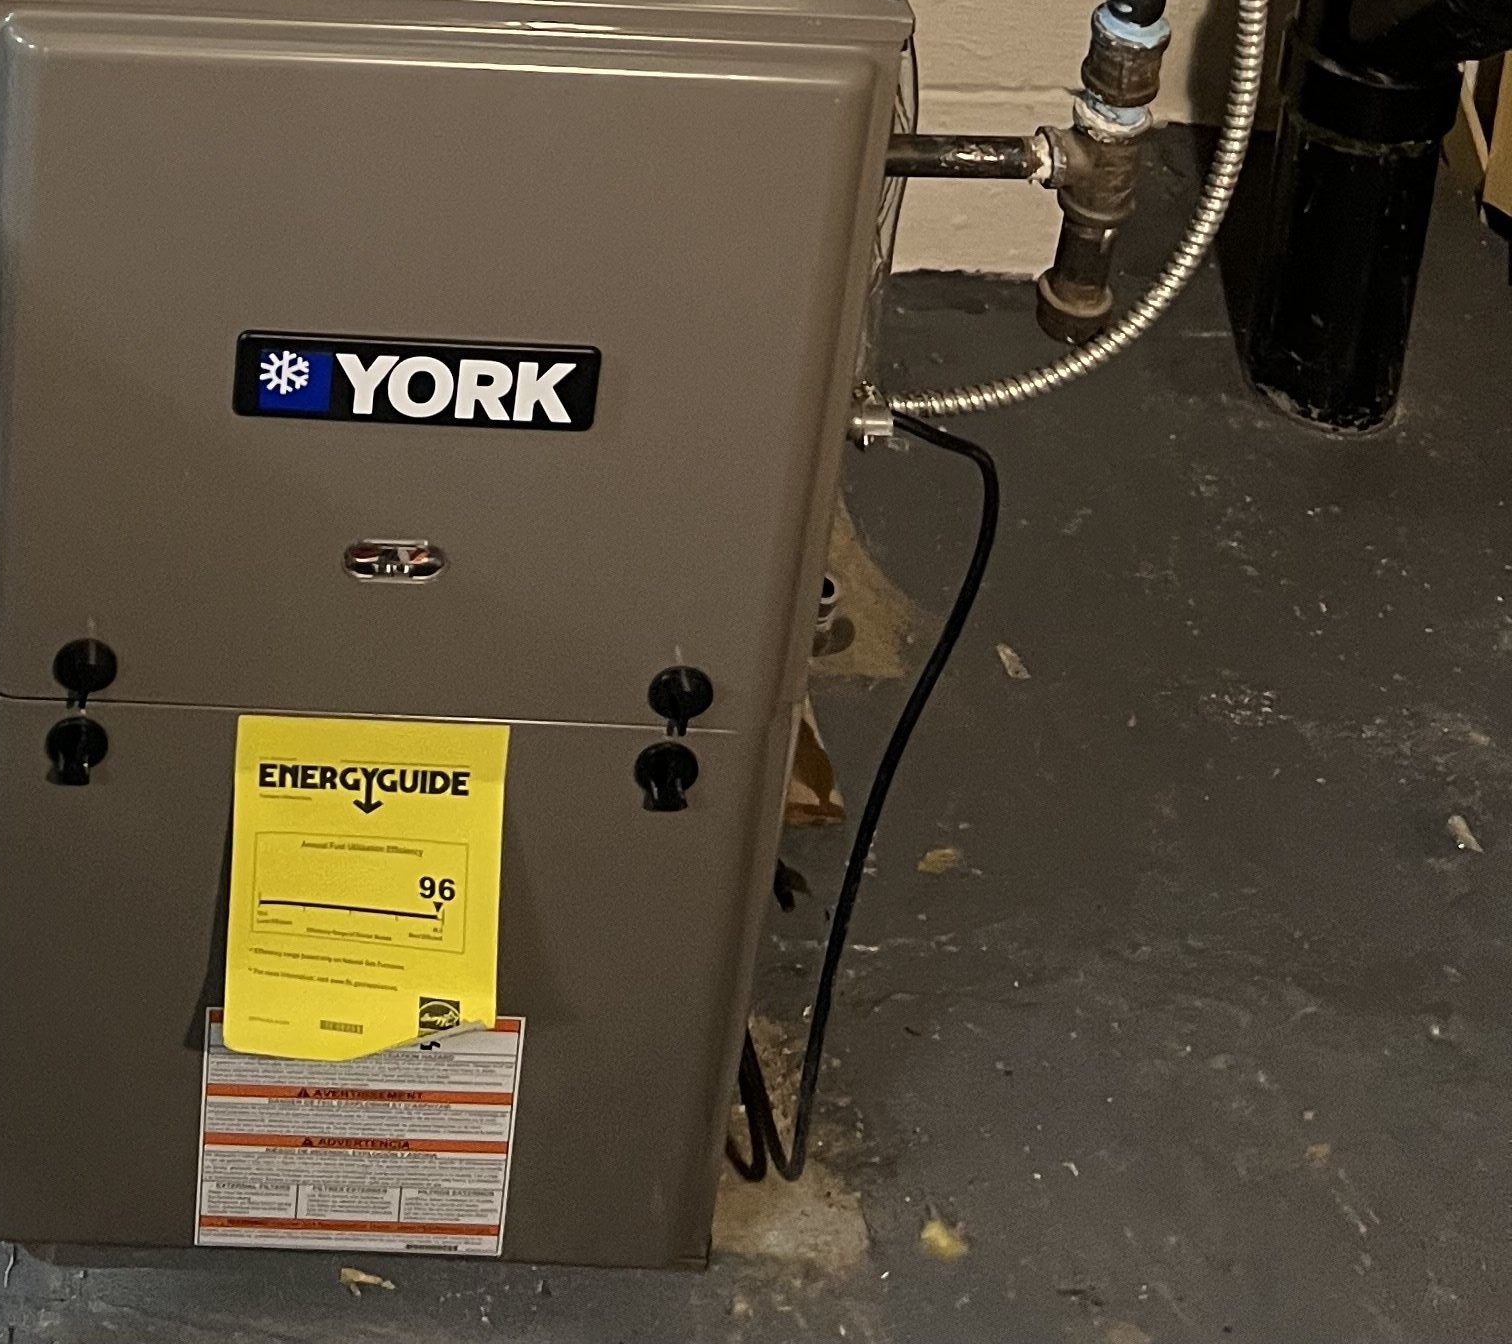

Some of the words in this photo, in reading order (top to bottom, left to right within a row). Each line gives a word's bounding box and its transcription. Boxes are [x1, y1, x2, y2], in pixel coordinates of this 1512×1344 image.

[335, 352, 577, 424] YORK
[258, 762, 471, 804] ENERGYGUIDE
[418, 876, 456, 901] 96
